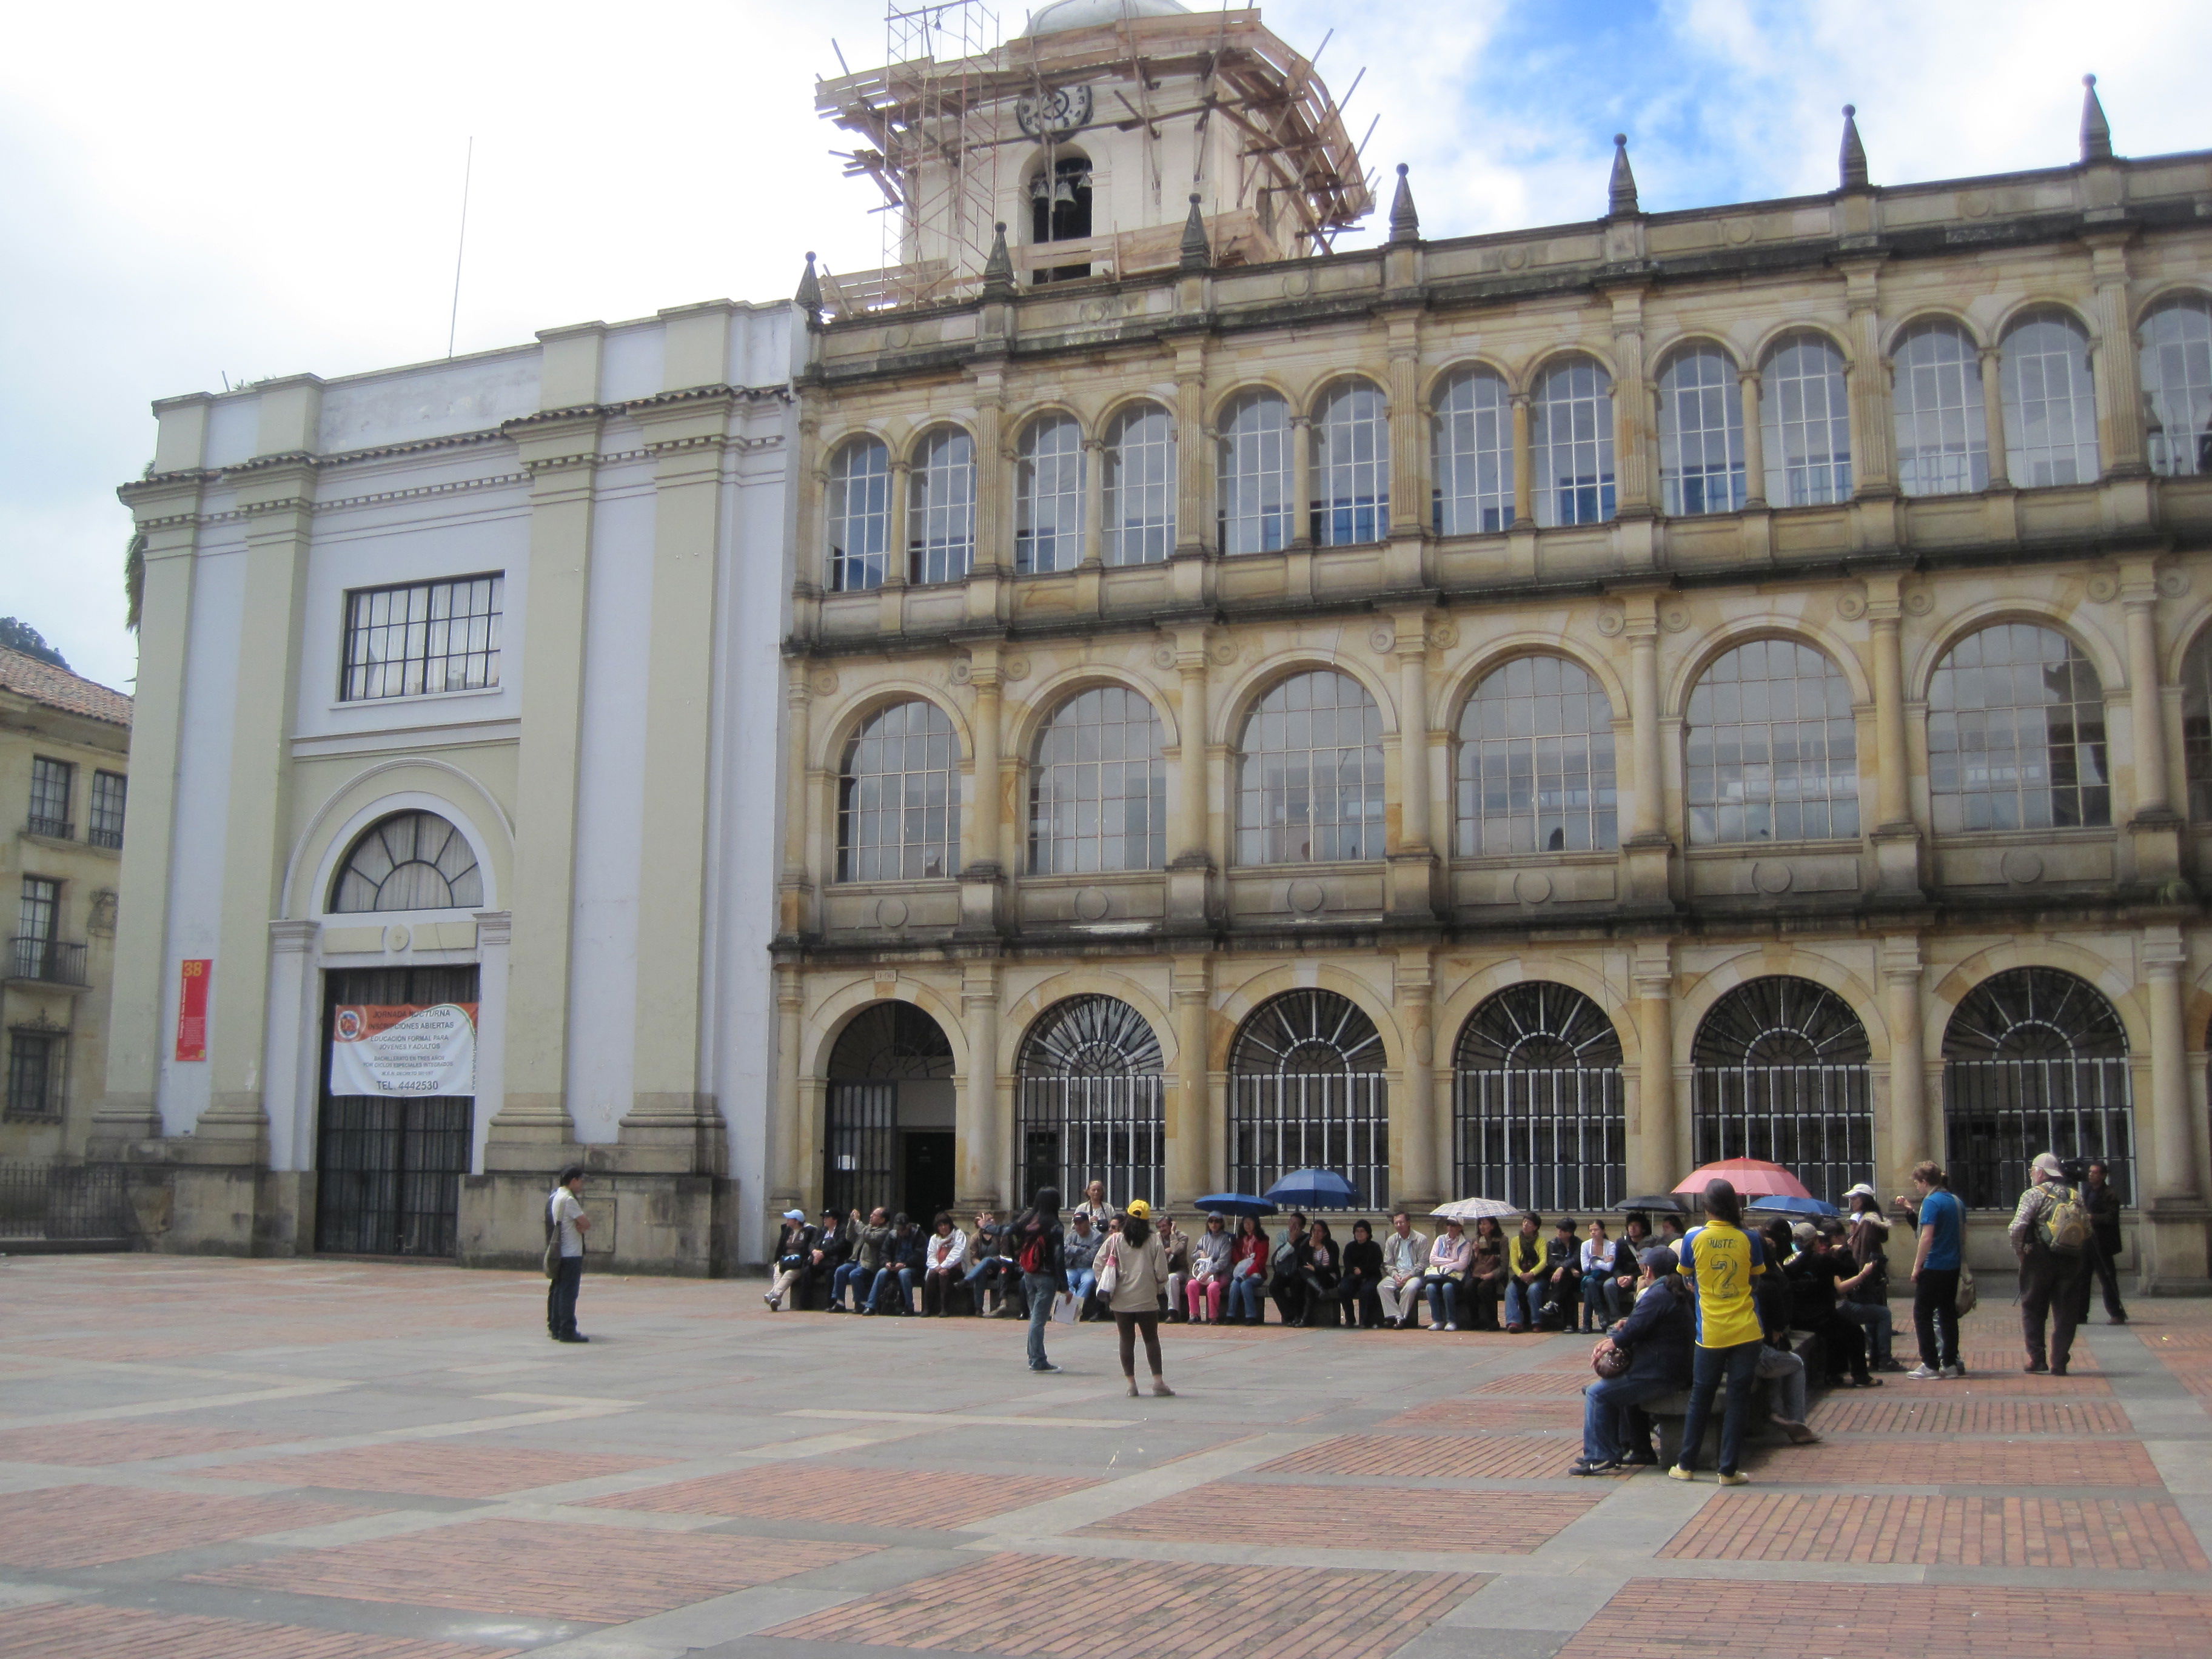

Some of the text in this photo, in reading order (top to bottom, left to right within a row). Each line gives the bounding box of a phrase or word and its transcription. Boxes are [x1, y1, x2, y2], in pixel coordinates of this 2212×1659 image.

[1078, 96, 1085, 104] 3
[184, 962, 202, 977] 38
[373, 1010, 451, 1019] JORNADA NOCTURNA
[368, 1021, 420, 1030] INSCRIPCIONES
[376, 1081, 438, 1090] TEL. 4442530
[1710, 1254, 1738, 1298] 2
